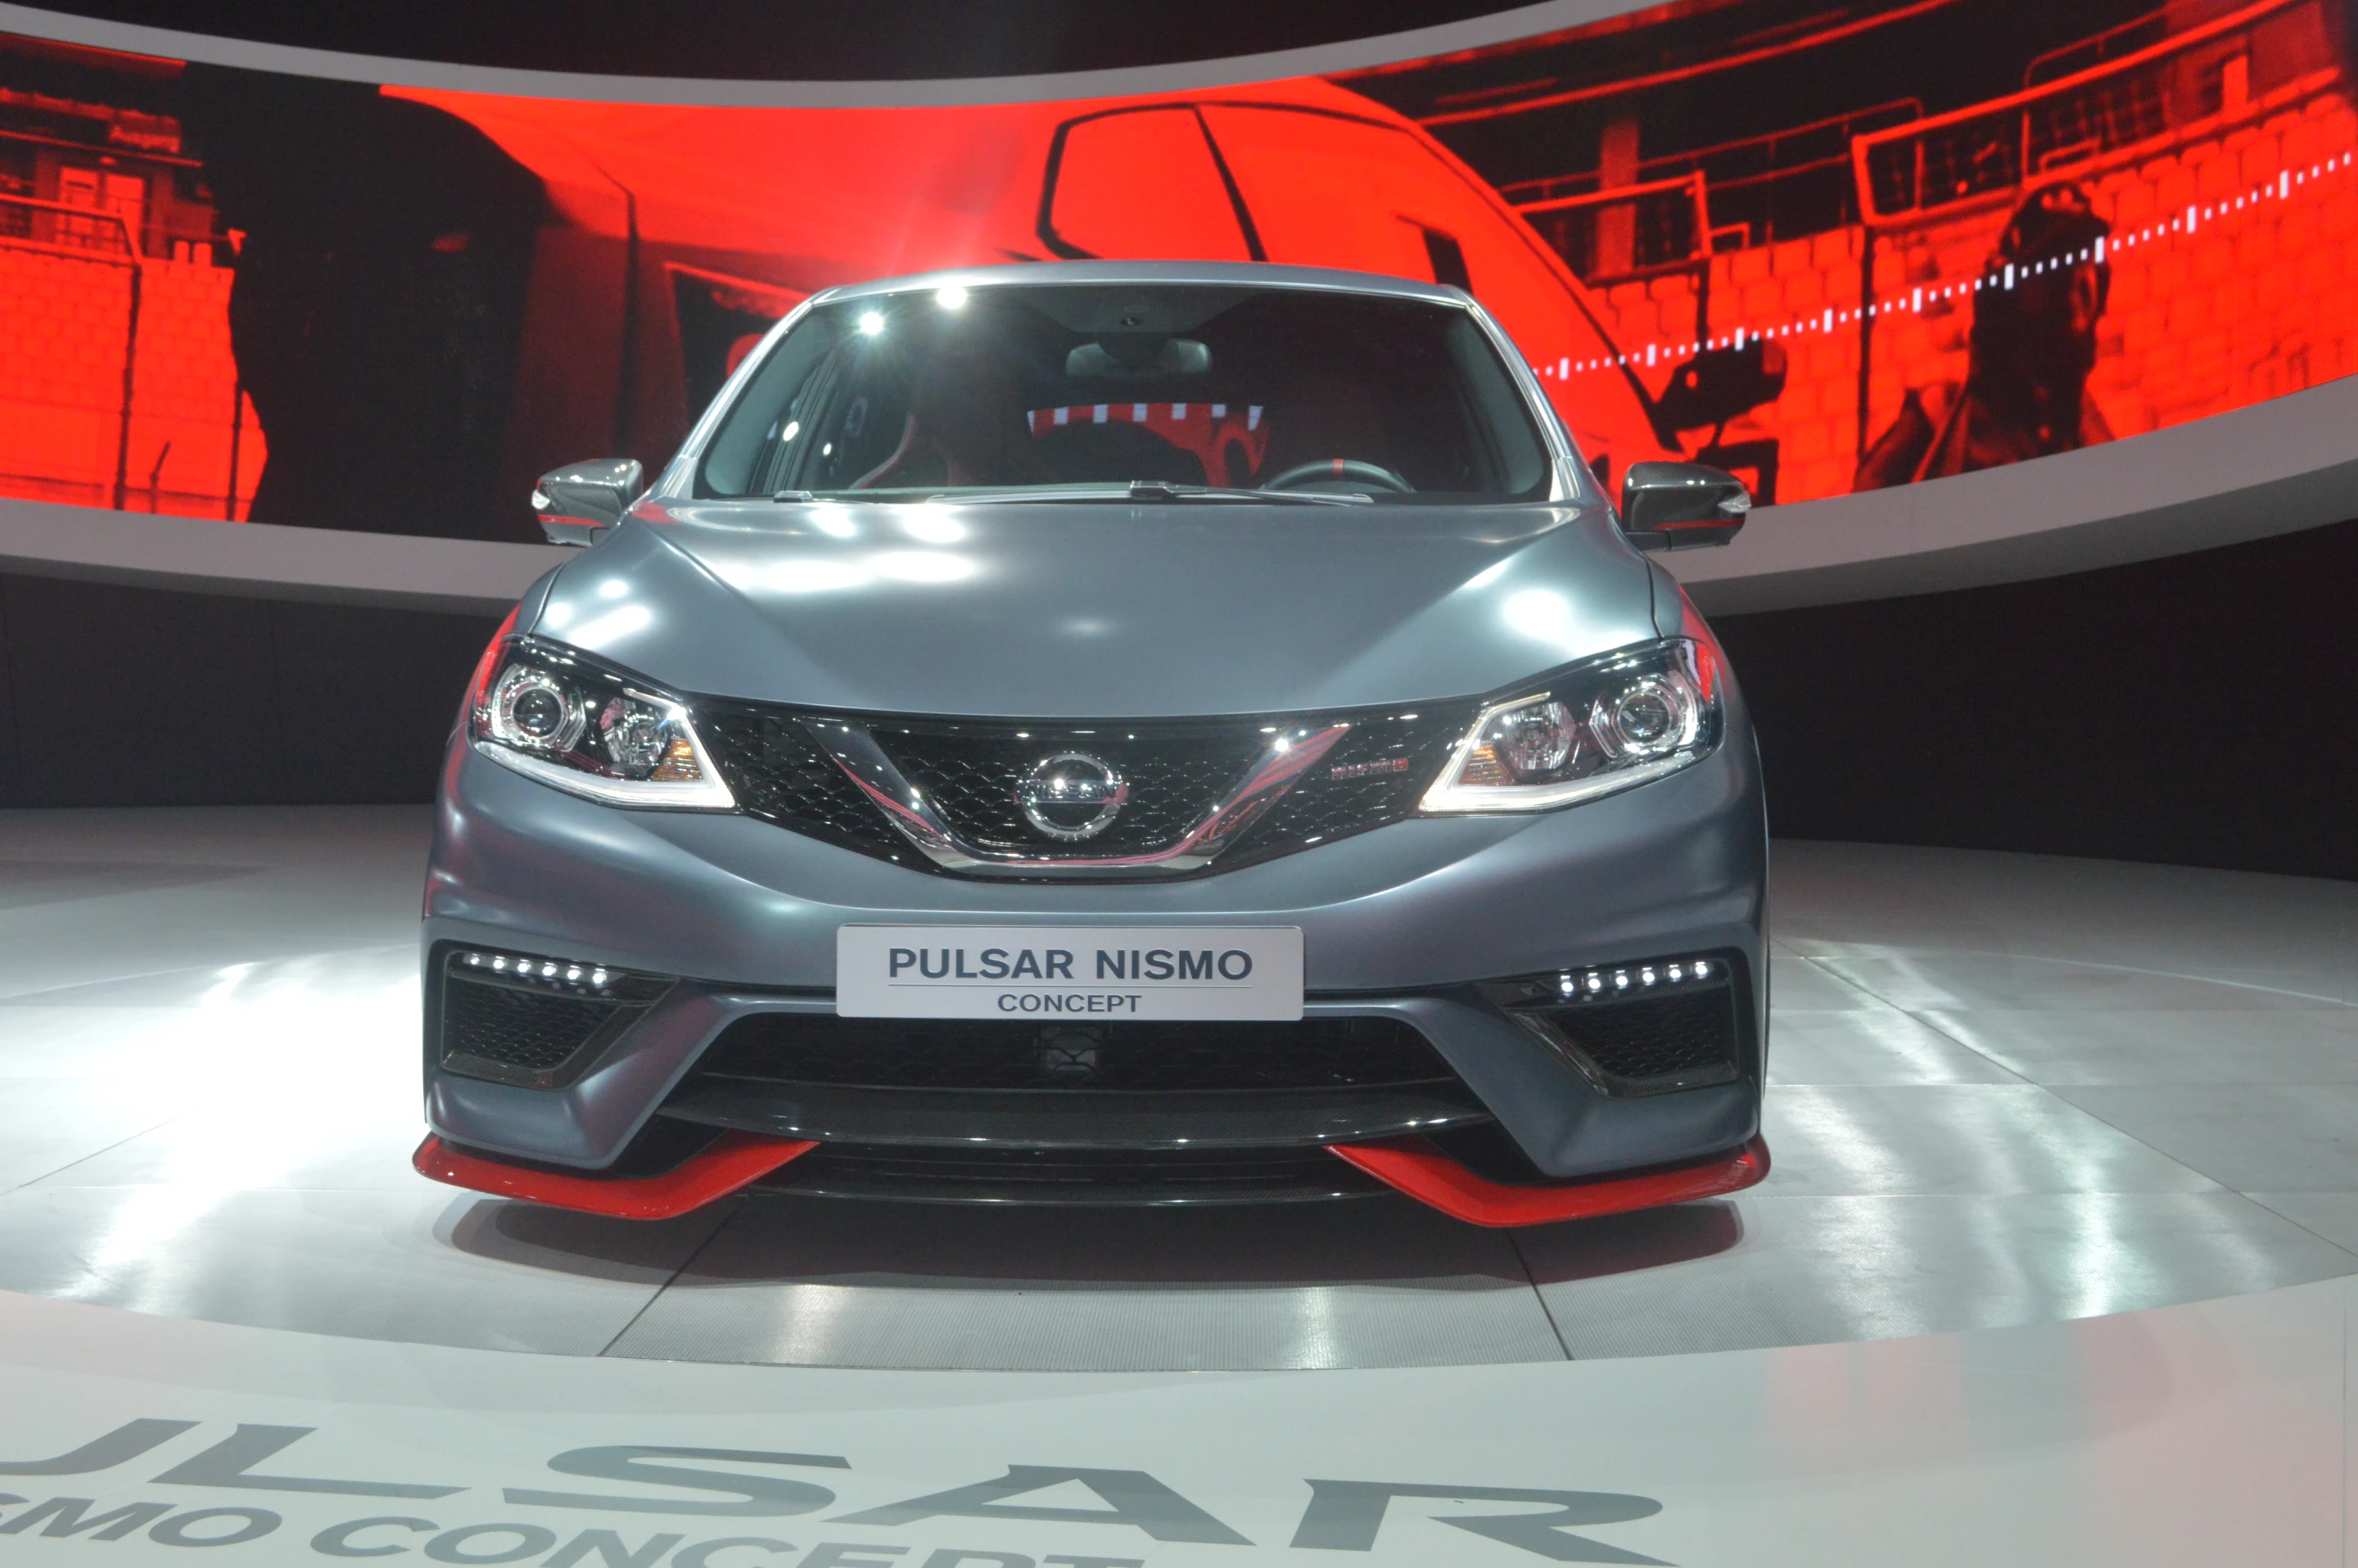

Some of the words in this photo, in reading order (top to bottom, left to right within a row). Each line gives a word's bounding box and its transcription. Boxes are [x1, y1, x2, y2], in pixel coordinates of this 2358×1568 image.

[889, 947, 1074, 979] PULSAR
[1095, 949, 1253, 981] NISMO
[996, 992, 1143, 1014] CONCEPT
[309, 1516, 1145, 1568] CONCE
